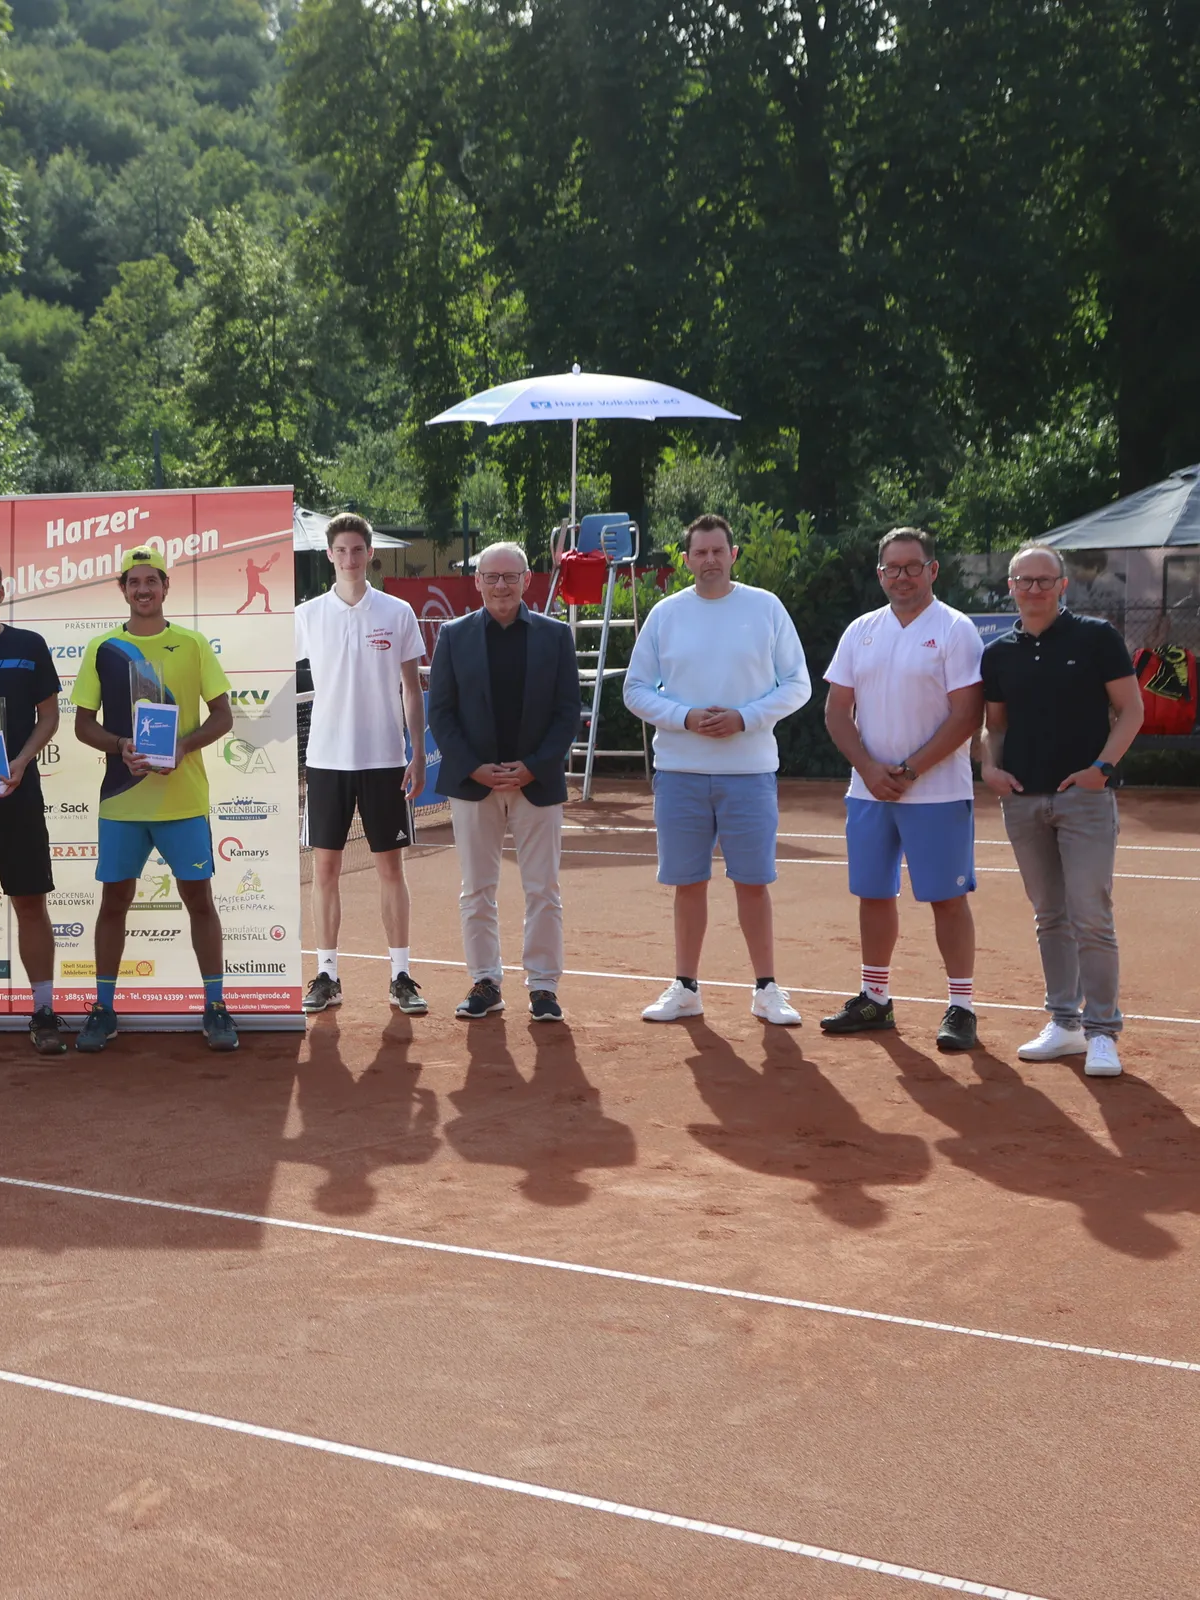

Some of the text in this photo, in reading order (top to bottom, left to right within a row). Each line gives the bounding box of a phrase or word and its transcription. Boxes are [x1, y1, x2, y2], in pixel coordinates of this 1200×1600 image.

[46, 506, 150, 549] Harzer-
[64, 621, 119, 630] PRÄSENTIERT
[977, 623, 997, 637] pen
[231, 690, 270, 705] KV
[52, 846, 97, 857] RATI
[230, 848, 270, 858] Kamarys
[214, 893, 266, 903] HASSERÖDER
[219, 903, 276, 913] FERIENPARK
[222, 933, 268, 941] ZKRISTALL
[224, 960, 287, 974] ksstimme
[129, 992, 141, 1000] Tel.
[142, 993, 163, 1001] 03943
[164, 993, 184, 1001] 43399
